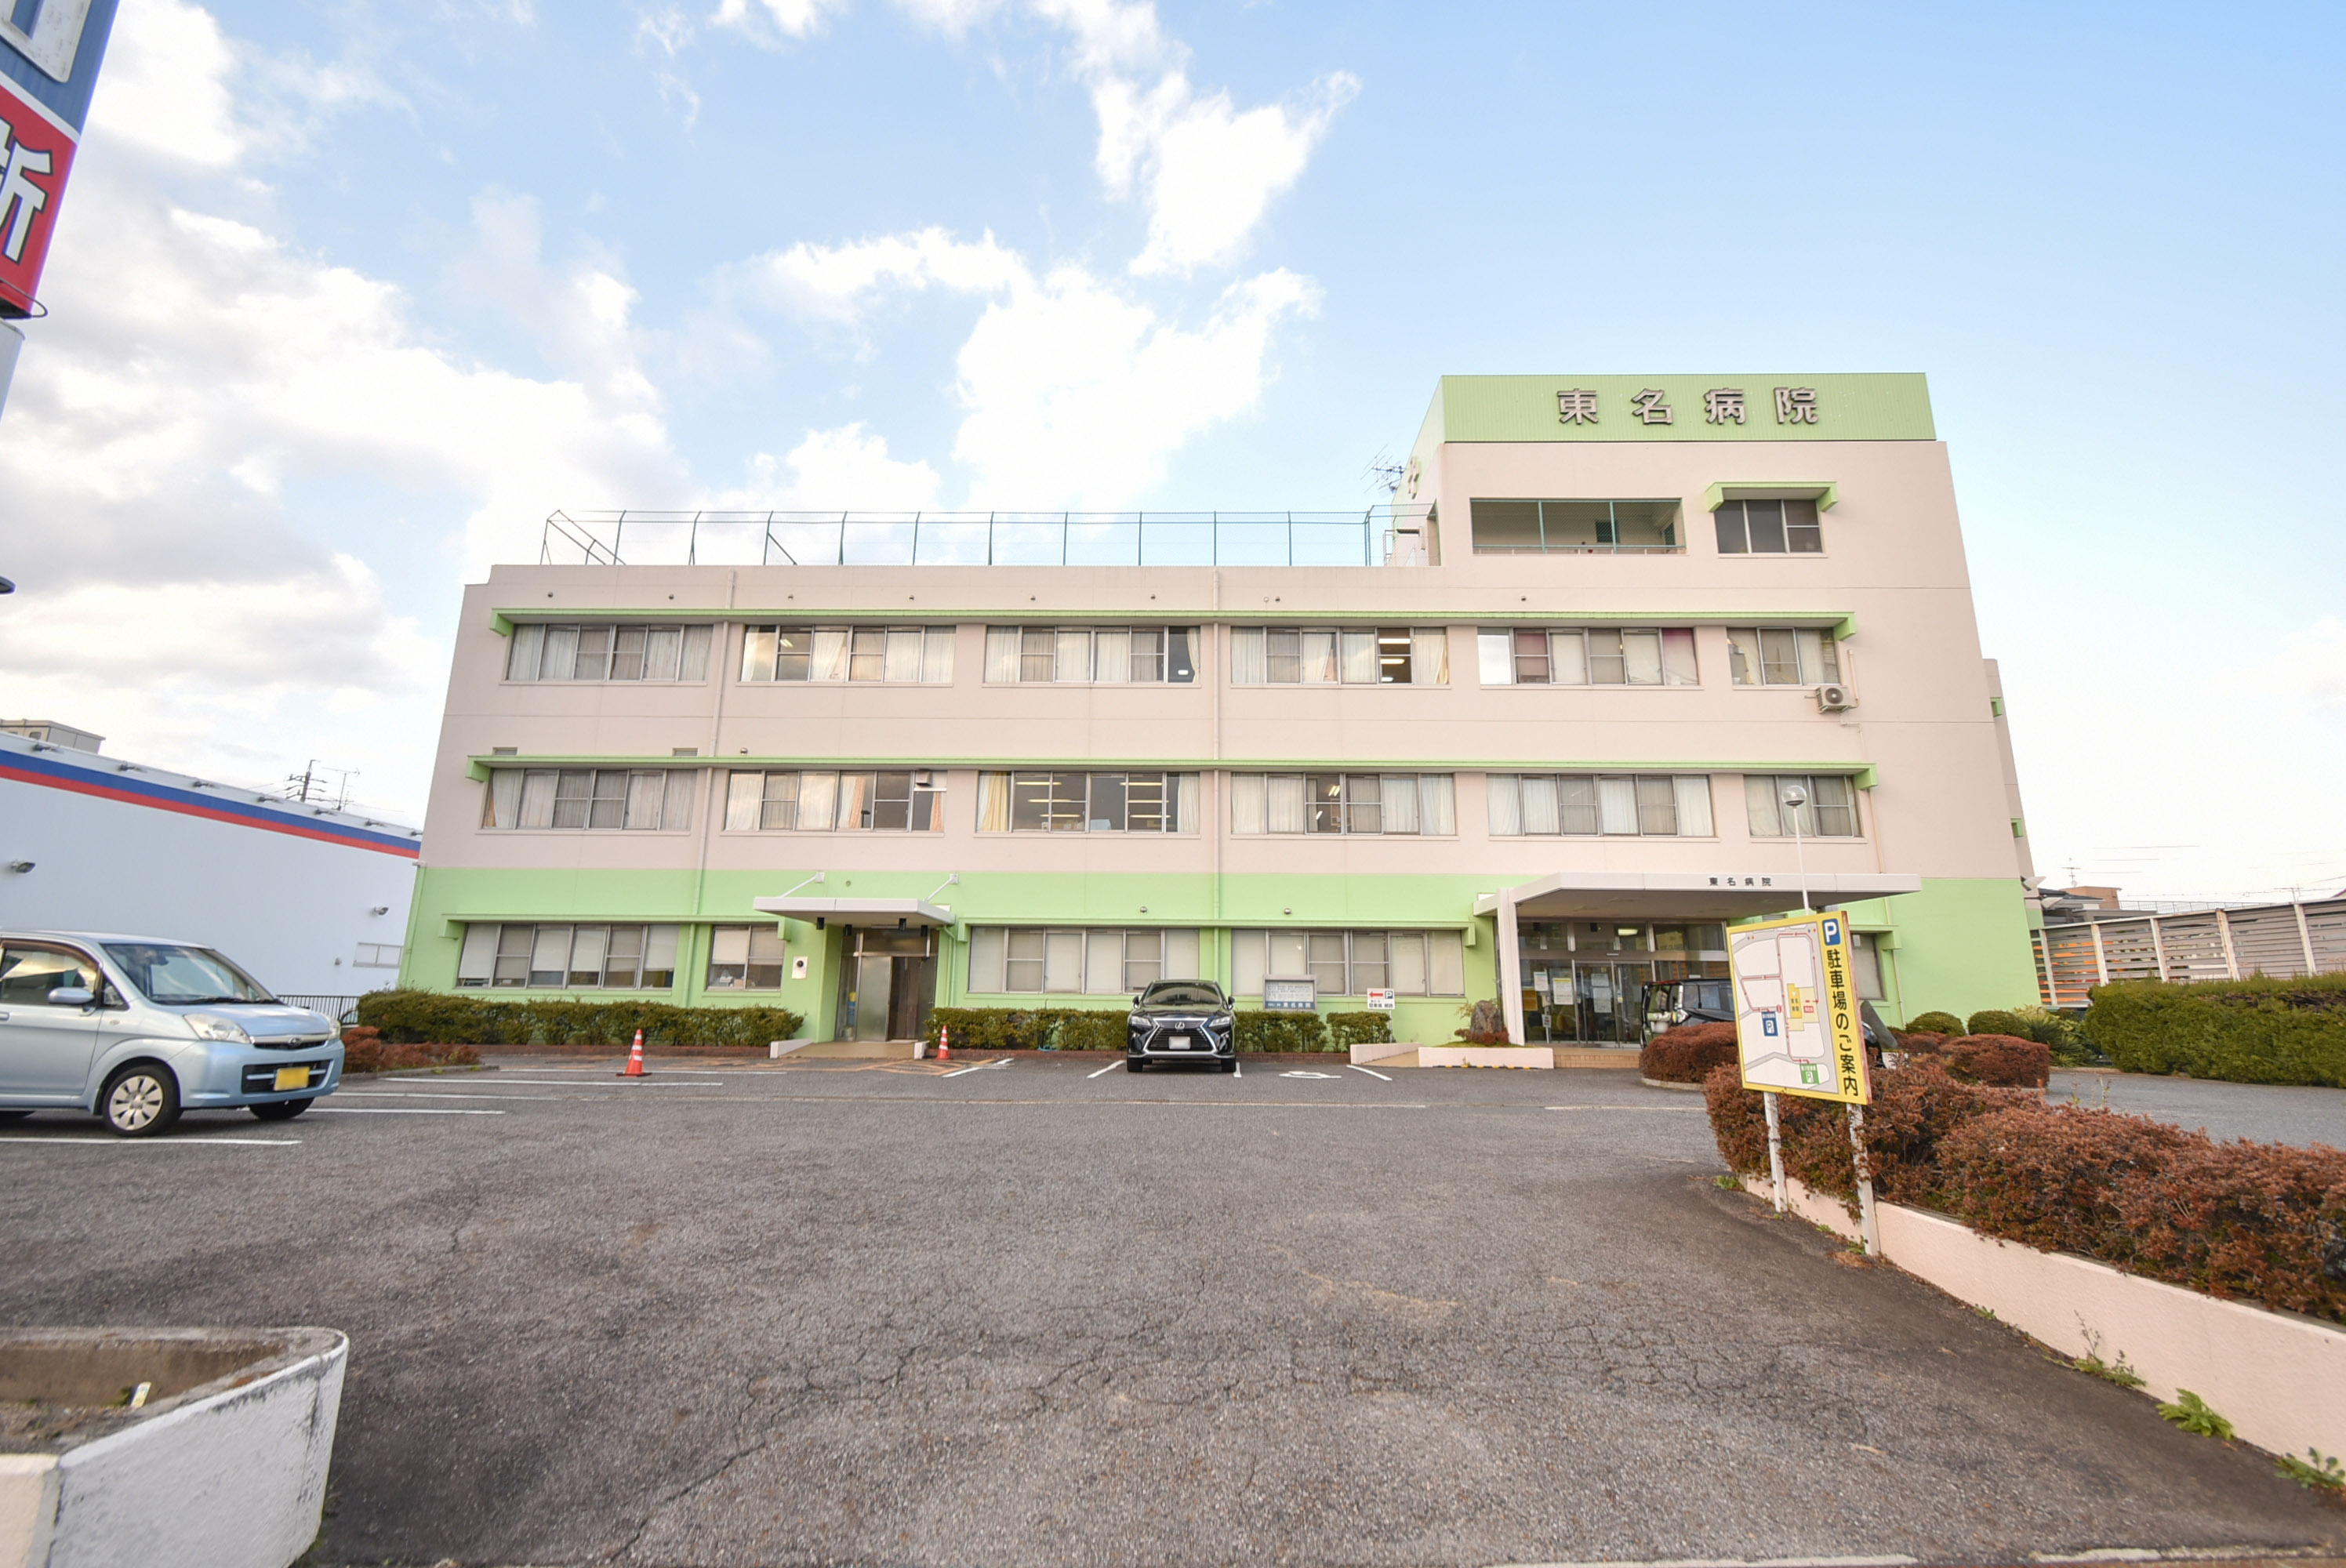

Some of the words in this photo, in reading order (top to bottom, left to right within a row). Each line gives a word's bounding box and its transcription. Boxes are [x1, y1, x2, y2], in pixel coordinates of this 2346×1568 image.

[1556, 387, 1819, 426] 東名病院
[1709, 877, 1772, 887] 東名病院
[1824, 921, 1837, 943] P
[1826, 948, 1859, 1097] 駐車場のご案内
